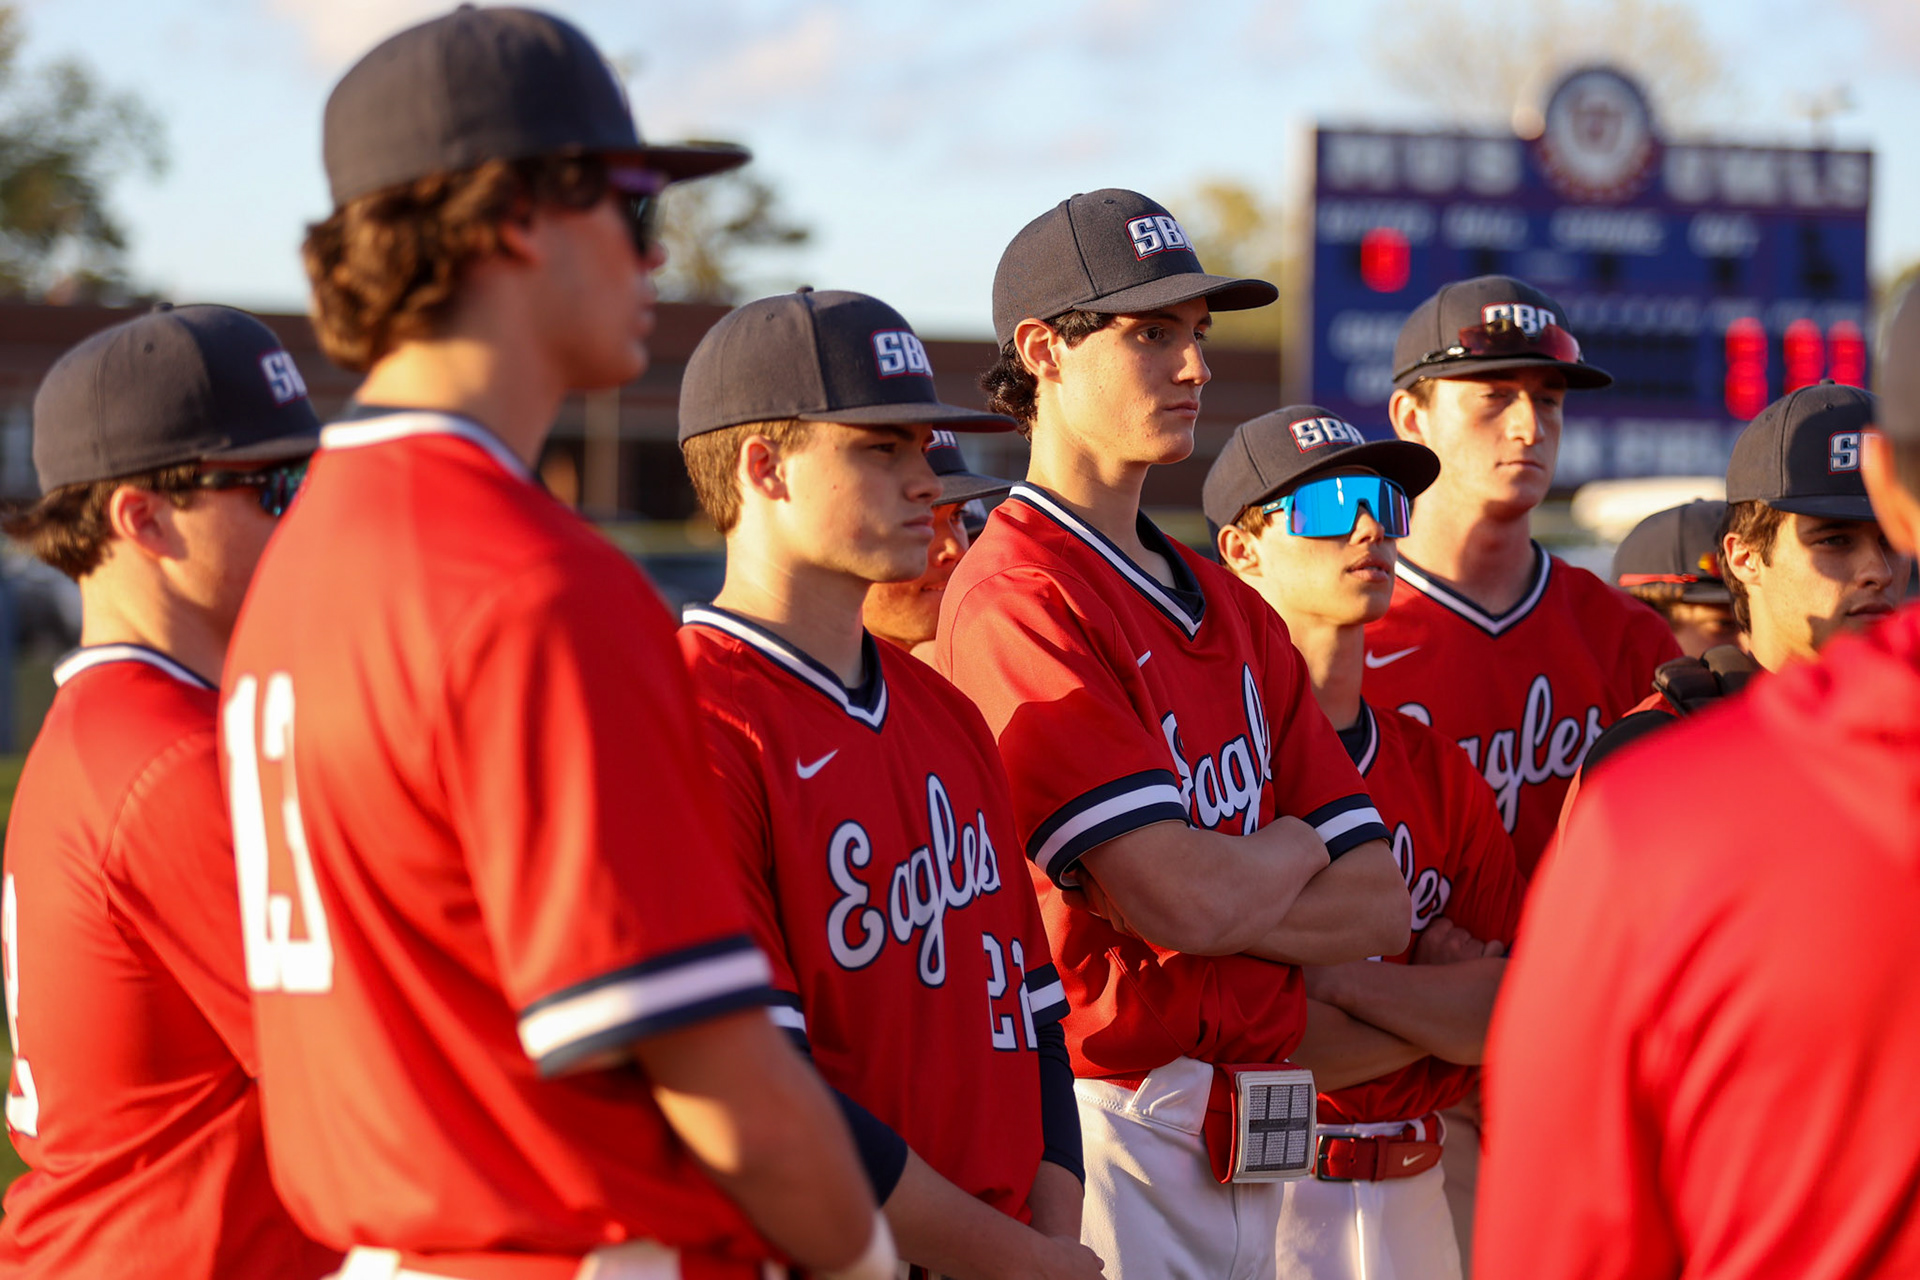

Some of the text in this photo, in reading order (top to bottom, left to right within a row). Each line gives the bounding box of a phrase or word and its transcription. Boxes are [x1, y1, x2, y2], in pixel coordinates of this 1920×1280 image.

[1126, 214, 1195, 260] SB
[224, 670, 334, 993] 13
[827, 772, 1001, 988] Eagles
